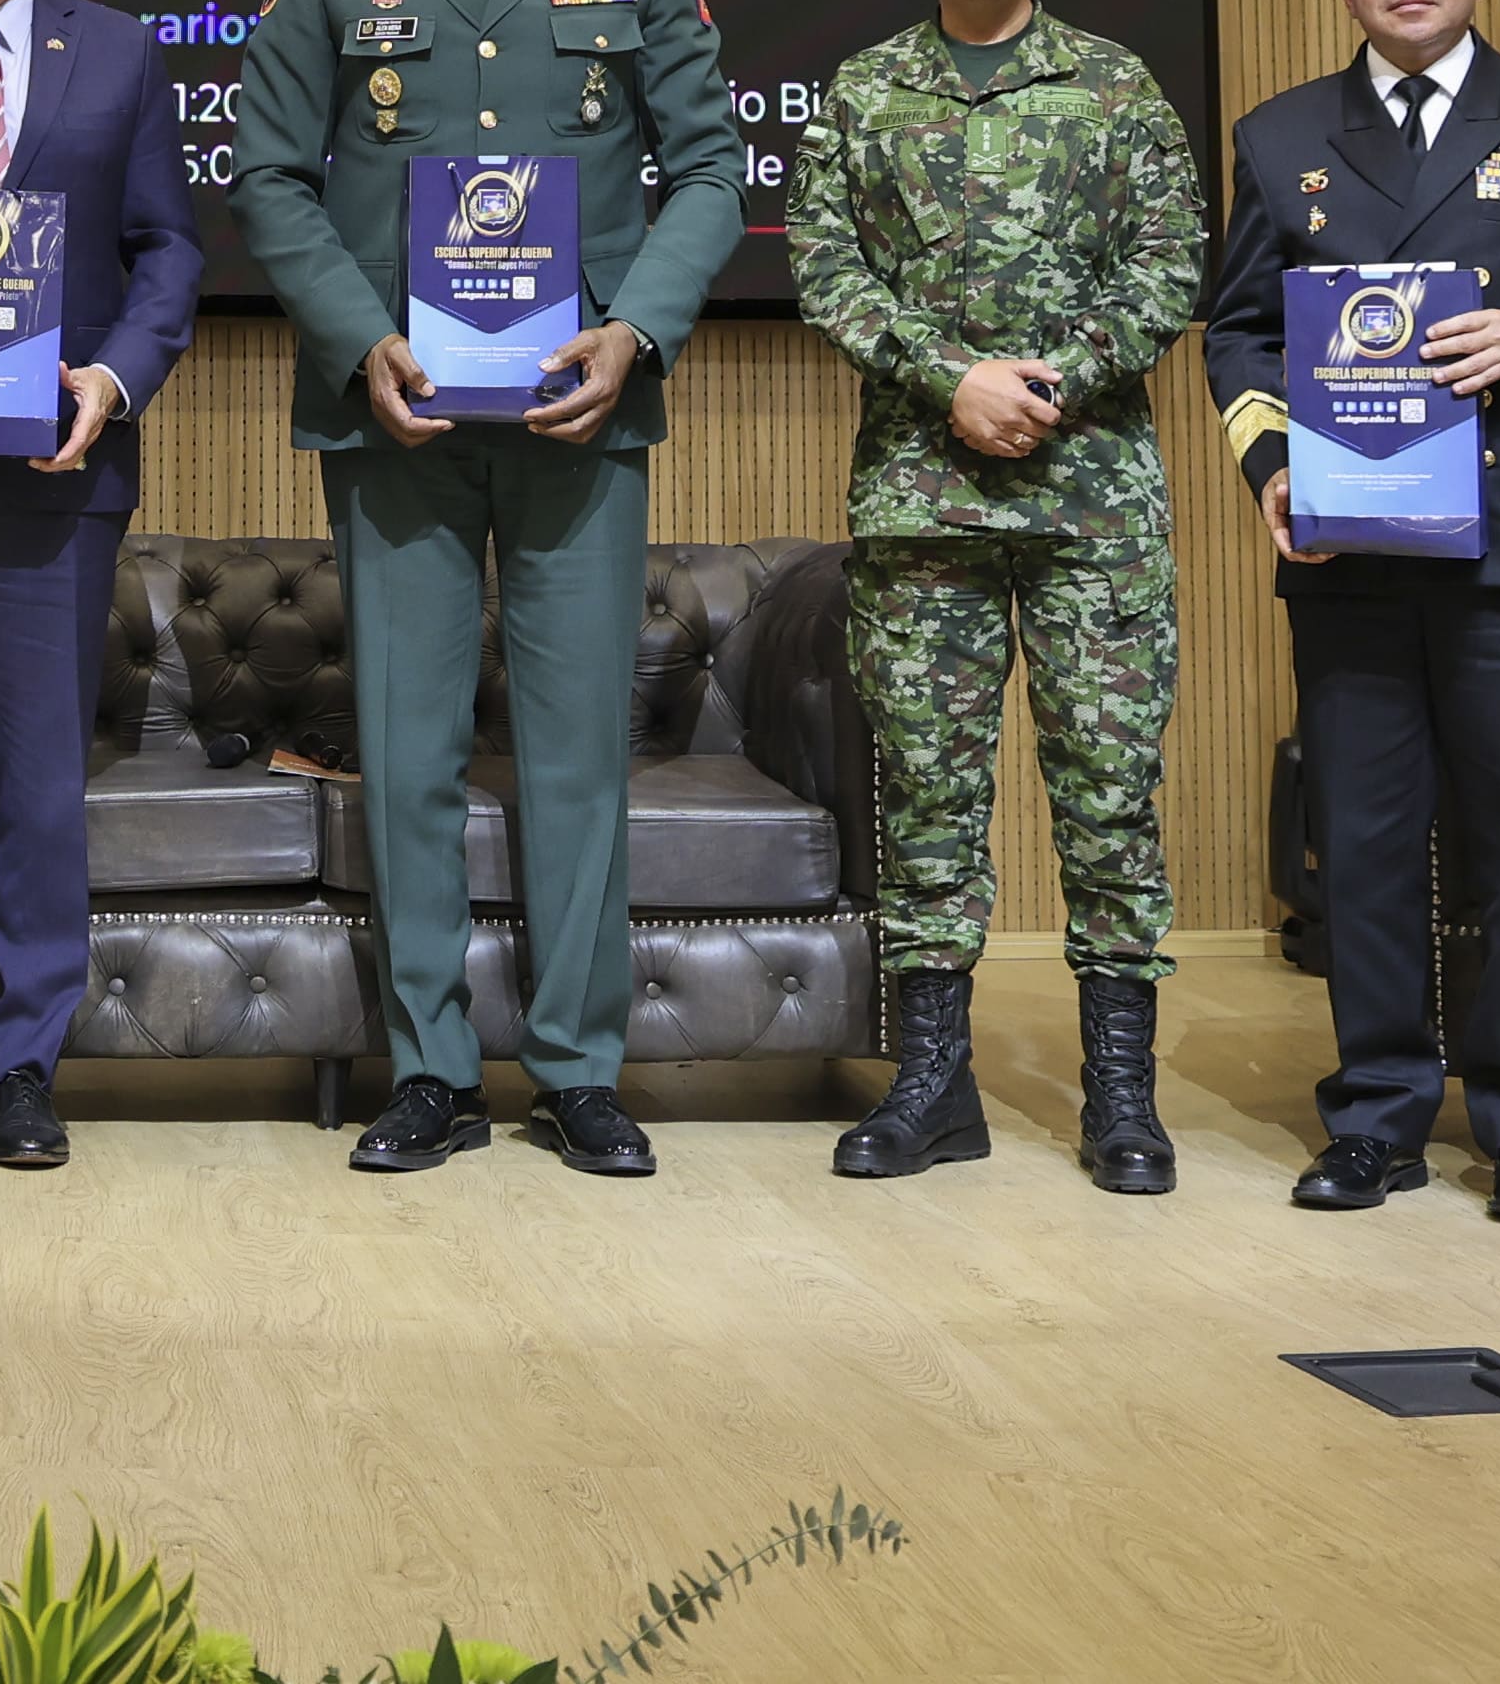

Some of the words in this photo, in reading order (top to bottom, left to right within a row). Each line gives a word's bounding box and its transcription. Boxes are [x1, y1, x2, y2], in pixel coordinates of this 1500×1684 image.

[434, 246, 468, 258] ESCUELA
[469, 246, 509, 258] SUPERIOR
[510, 247, 521, 259] DE
[522, 247, 553, 259] GUERRA
[3, 279, 35, 291] GUERRA
[1313, 366, 1351, 379] ESCUELA
[1351, 366, 1395, 379] SUPERIOR
[1396, 367, 1408, 379] DE
